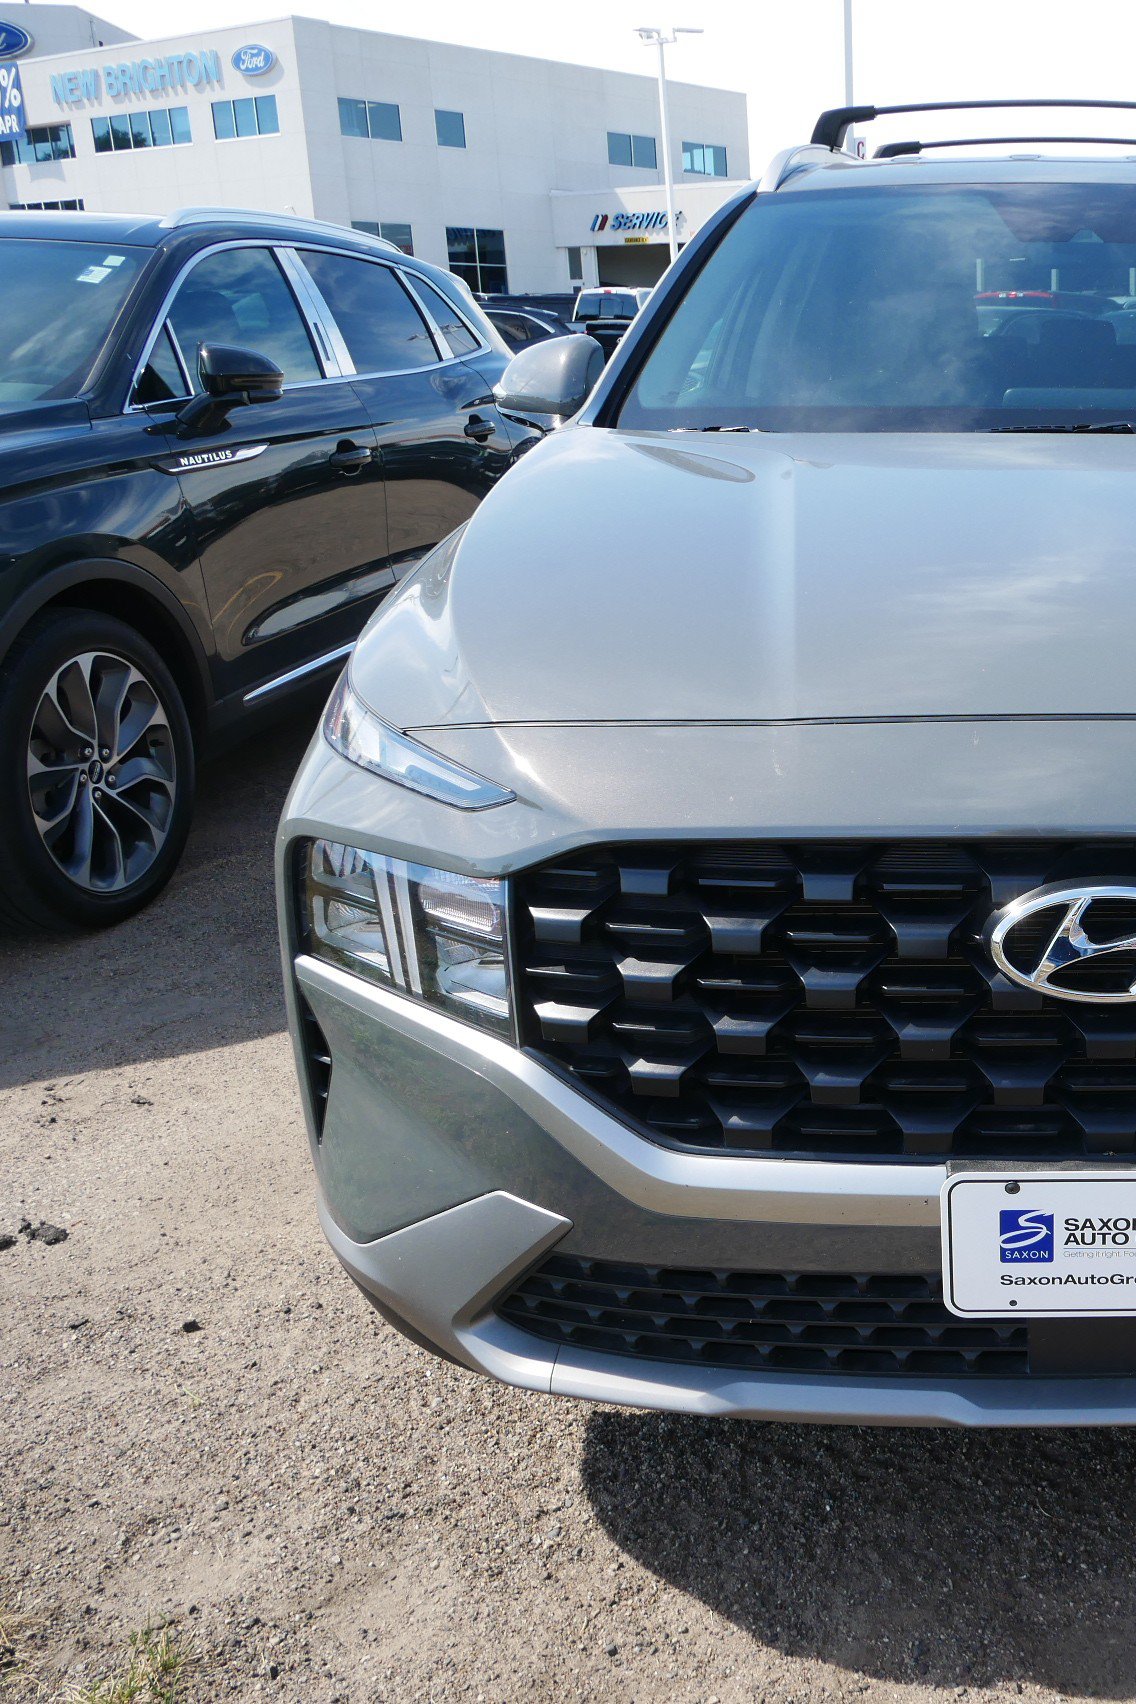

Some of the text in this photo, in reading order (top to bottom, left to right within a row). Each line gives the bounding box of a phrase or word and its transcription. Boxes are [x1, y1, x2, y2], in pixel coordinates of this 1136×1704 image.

[240, 49, 265, 70] Ford
[50, 50, 221, 102] NEW BRIGHTON
[610, 210, 682, 231] SERVIC
[180, 450, 233, 466] NAUTILUS
[1064, 1231, 1134, 1246] AUTO
[1005, 1251, 1049, 1259] SAXON
[1063, 1250, 1094, 1259] Getting
